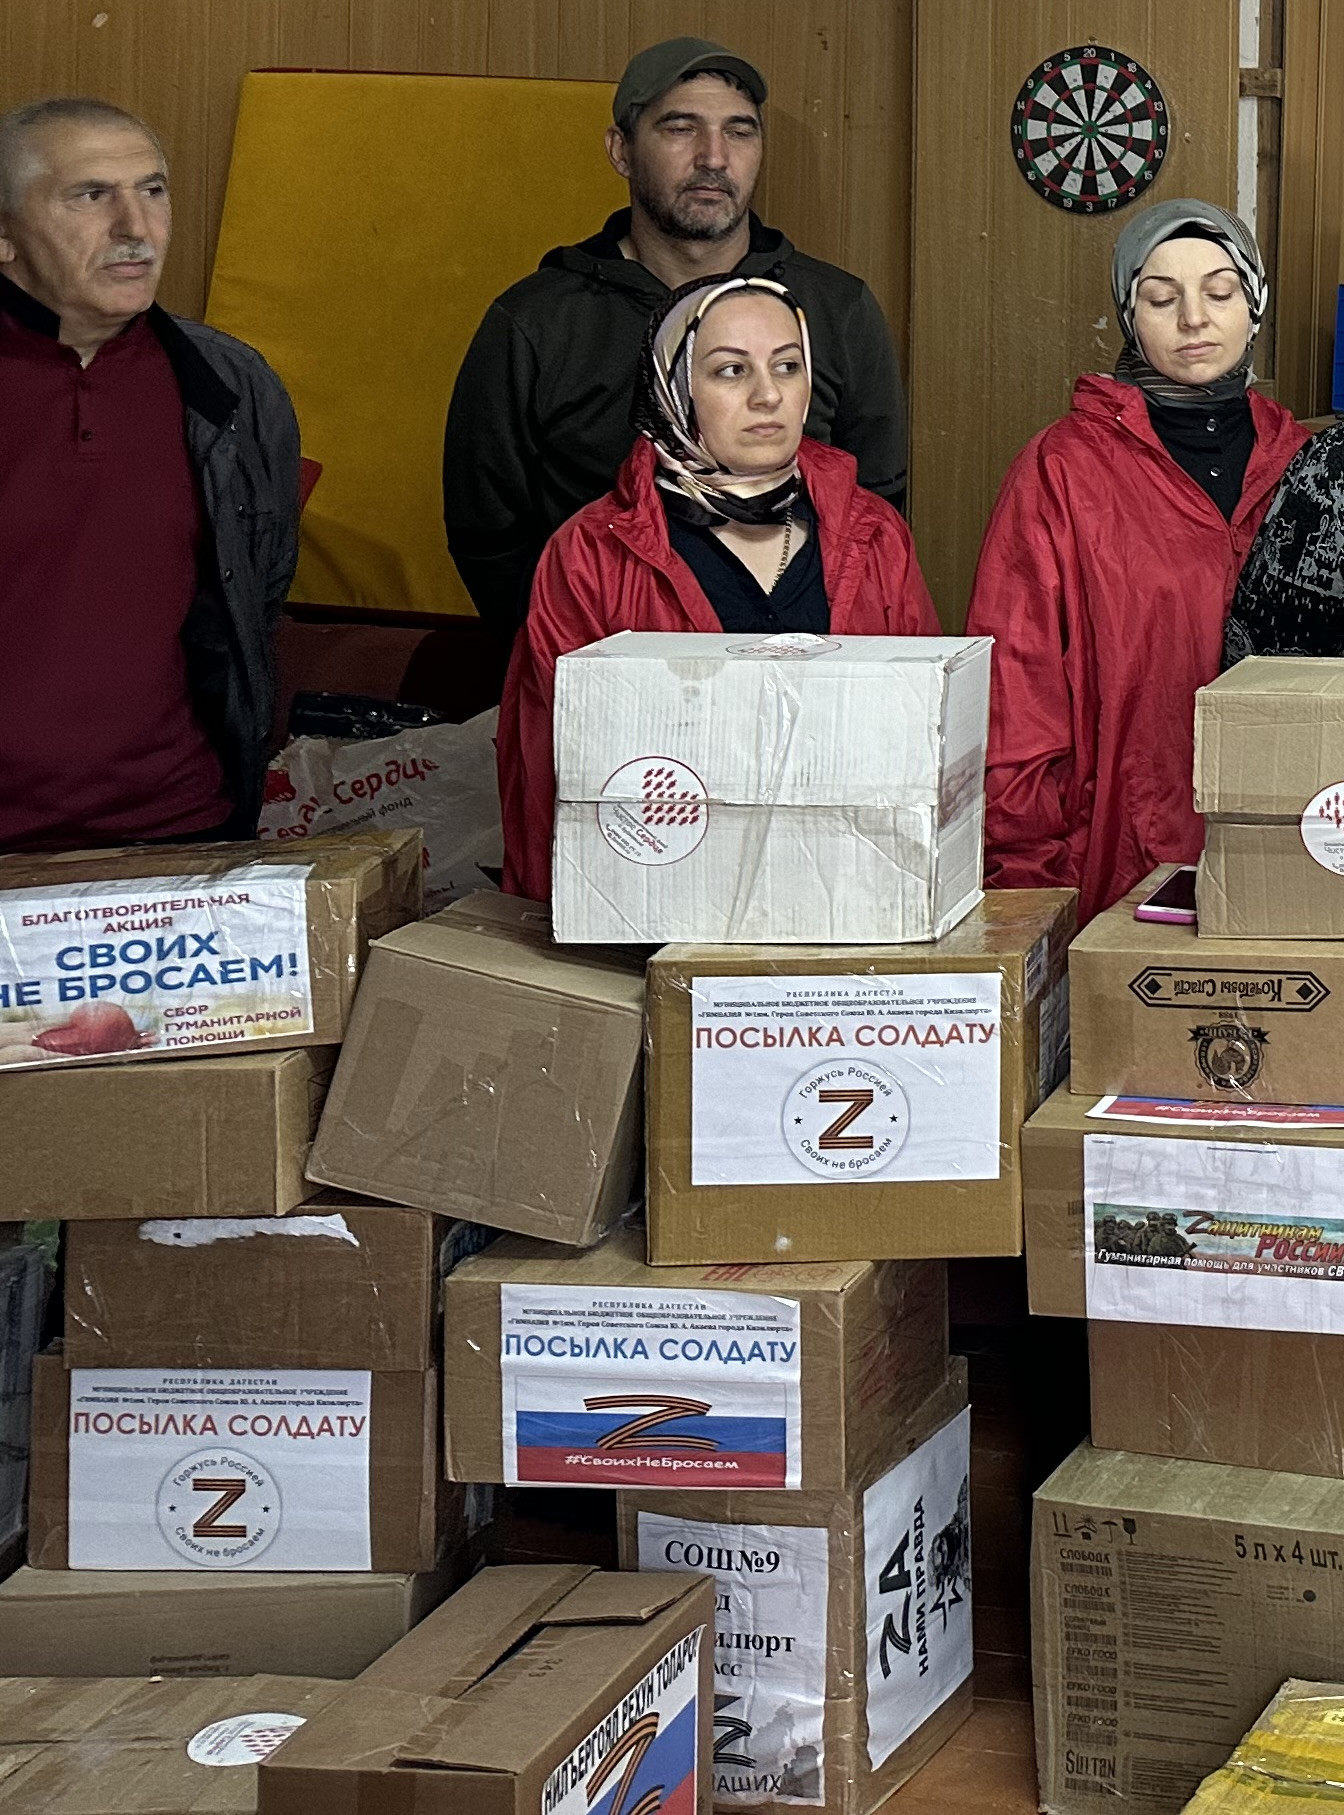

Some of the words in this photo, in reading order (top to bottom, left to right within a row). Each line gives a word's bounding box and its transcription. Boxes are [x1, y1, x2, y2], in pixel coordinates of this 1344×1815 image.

[1064, 52, 1070, 61] 5
[1083, 48, 1096, 58] 20
[1110, 52, 1115, 61] 1
[1027, 78, 1034, 89] 9
[1145, 80, 1152, 89] 4
[1017, 101, 1025, 110] 14
[1013, 125, 1022, 134] 11
[1160, 125, 1166, 135] 6
[1154, 149, 1163, 159] 10
[1044, 187, 1050, 197] 7
[1128, 188, 1135, 197] 2
[1086, 201, 1093, 212] 3
[1108, 198, 1117, 208] 17
[22, 892, 250, 927] БЛАГОТВОРИТЕЛЬНАЯ
[103, 916, 173, 935] АКЦИЯ
[55, 930, 221, 972] СВОИХ
[58, 952, 299, 1002] БРОСАЕМ!
[1173, 978, 1216, 997] Сласти
[163, 1004, 209, 1019] СБОР
[165, 1006, 302, 1033] ГУМАНИТАРНОЙ
[166, 1030, 245, 1047] ПОМОЩИ
[696, 1026, 845, 1049] ПОСЫЛКА
[854, 1023, 996, 1048] СОЛДАТУ
[799, 1067, 845, 1099] Горжусь
[847, 1066, 893, 1098] Россией
[800, 1138, 830, 1168] Своих
[831, 1160, 846, 1170] не
[848, 1137, 893, 1170] бросаем
[1098, 1248, 1181, 1267] Гуманитарная
[1184, 1257, 1229, 1270] помощь
[1232, 1260, 1254, 1271] для
[1257, 1262, 1324, 1277] участников
[505, 1333, 649, 1359] ПОСЫЛКА
[658, 1338, 797, 1364] СОЛДАТУ
[74, 1412, 218, 1436] ПОСЫЛКА
[228, 1414, 366, 1439] СОЛДАТУ
[172, 1458, 217, 1487] Горжусь
[220, 1457, 265, 1488] Россией
[564, 1454, 739, 1471] #СвоихНеБросаем
[175, 1526, 204, 1555] Своих
[205, 1548, 220, 1557] не
[222, 1526, 265, 1558] бросаем
[913, 1494, 929, 1597] ПРАВДА
[665, 1539, 781, 1573] СОШ№9
[1235, 1534, 1247, 1559] 5
[1253, 1542, 1267, 1561] л
[1291, 1540, 1304, 1565] 4
[1310, 1548, 1343, 1571] шт.
[713, 1630, 796, 1658] илюрт
[915, 1601, 930, 1677] НАМИ
[714, 1773, 783, 1794] АШИХ
